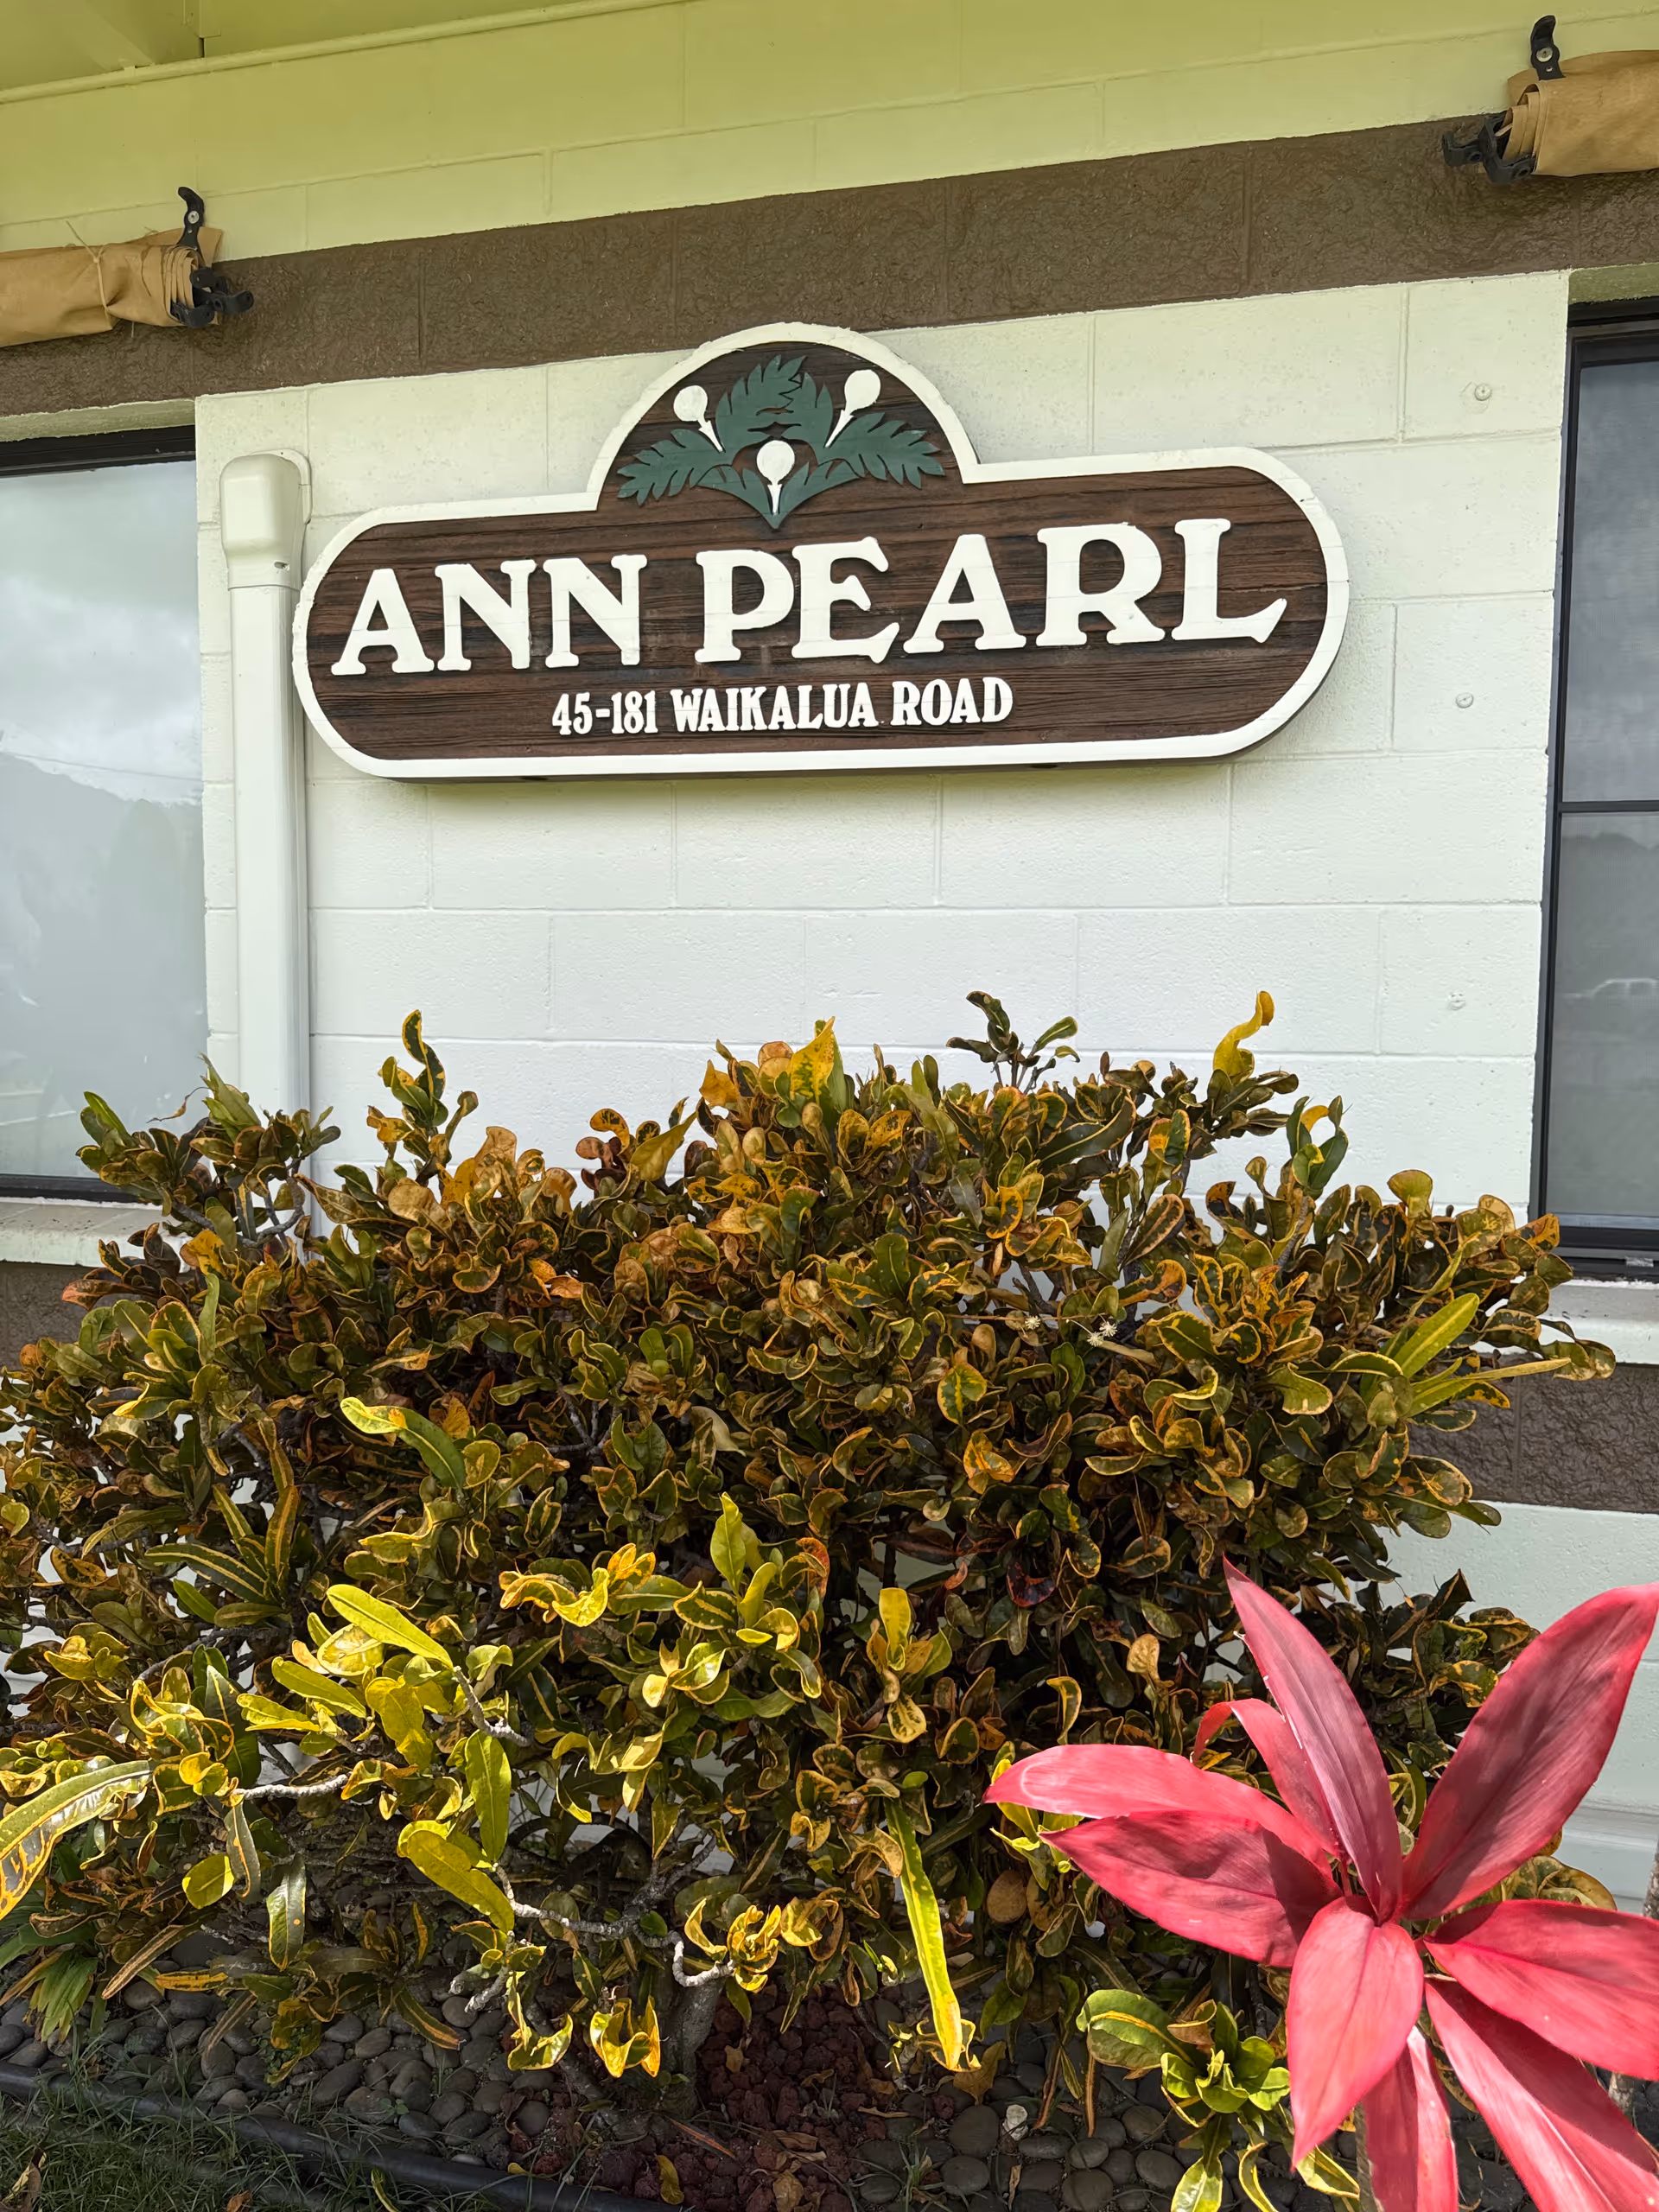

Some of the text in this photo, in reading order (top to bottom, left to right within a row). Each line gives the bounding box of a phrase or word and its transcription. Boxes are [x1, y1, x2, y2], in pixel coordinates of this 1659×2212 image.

[330, 518, 1287, 676] ANN PEARL
[551, 677, 1014, 735] 45-181 WAIKALUA ROAD
